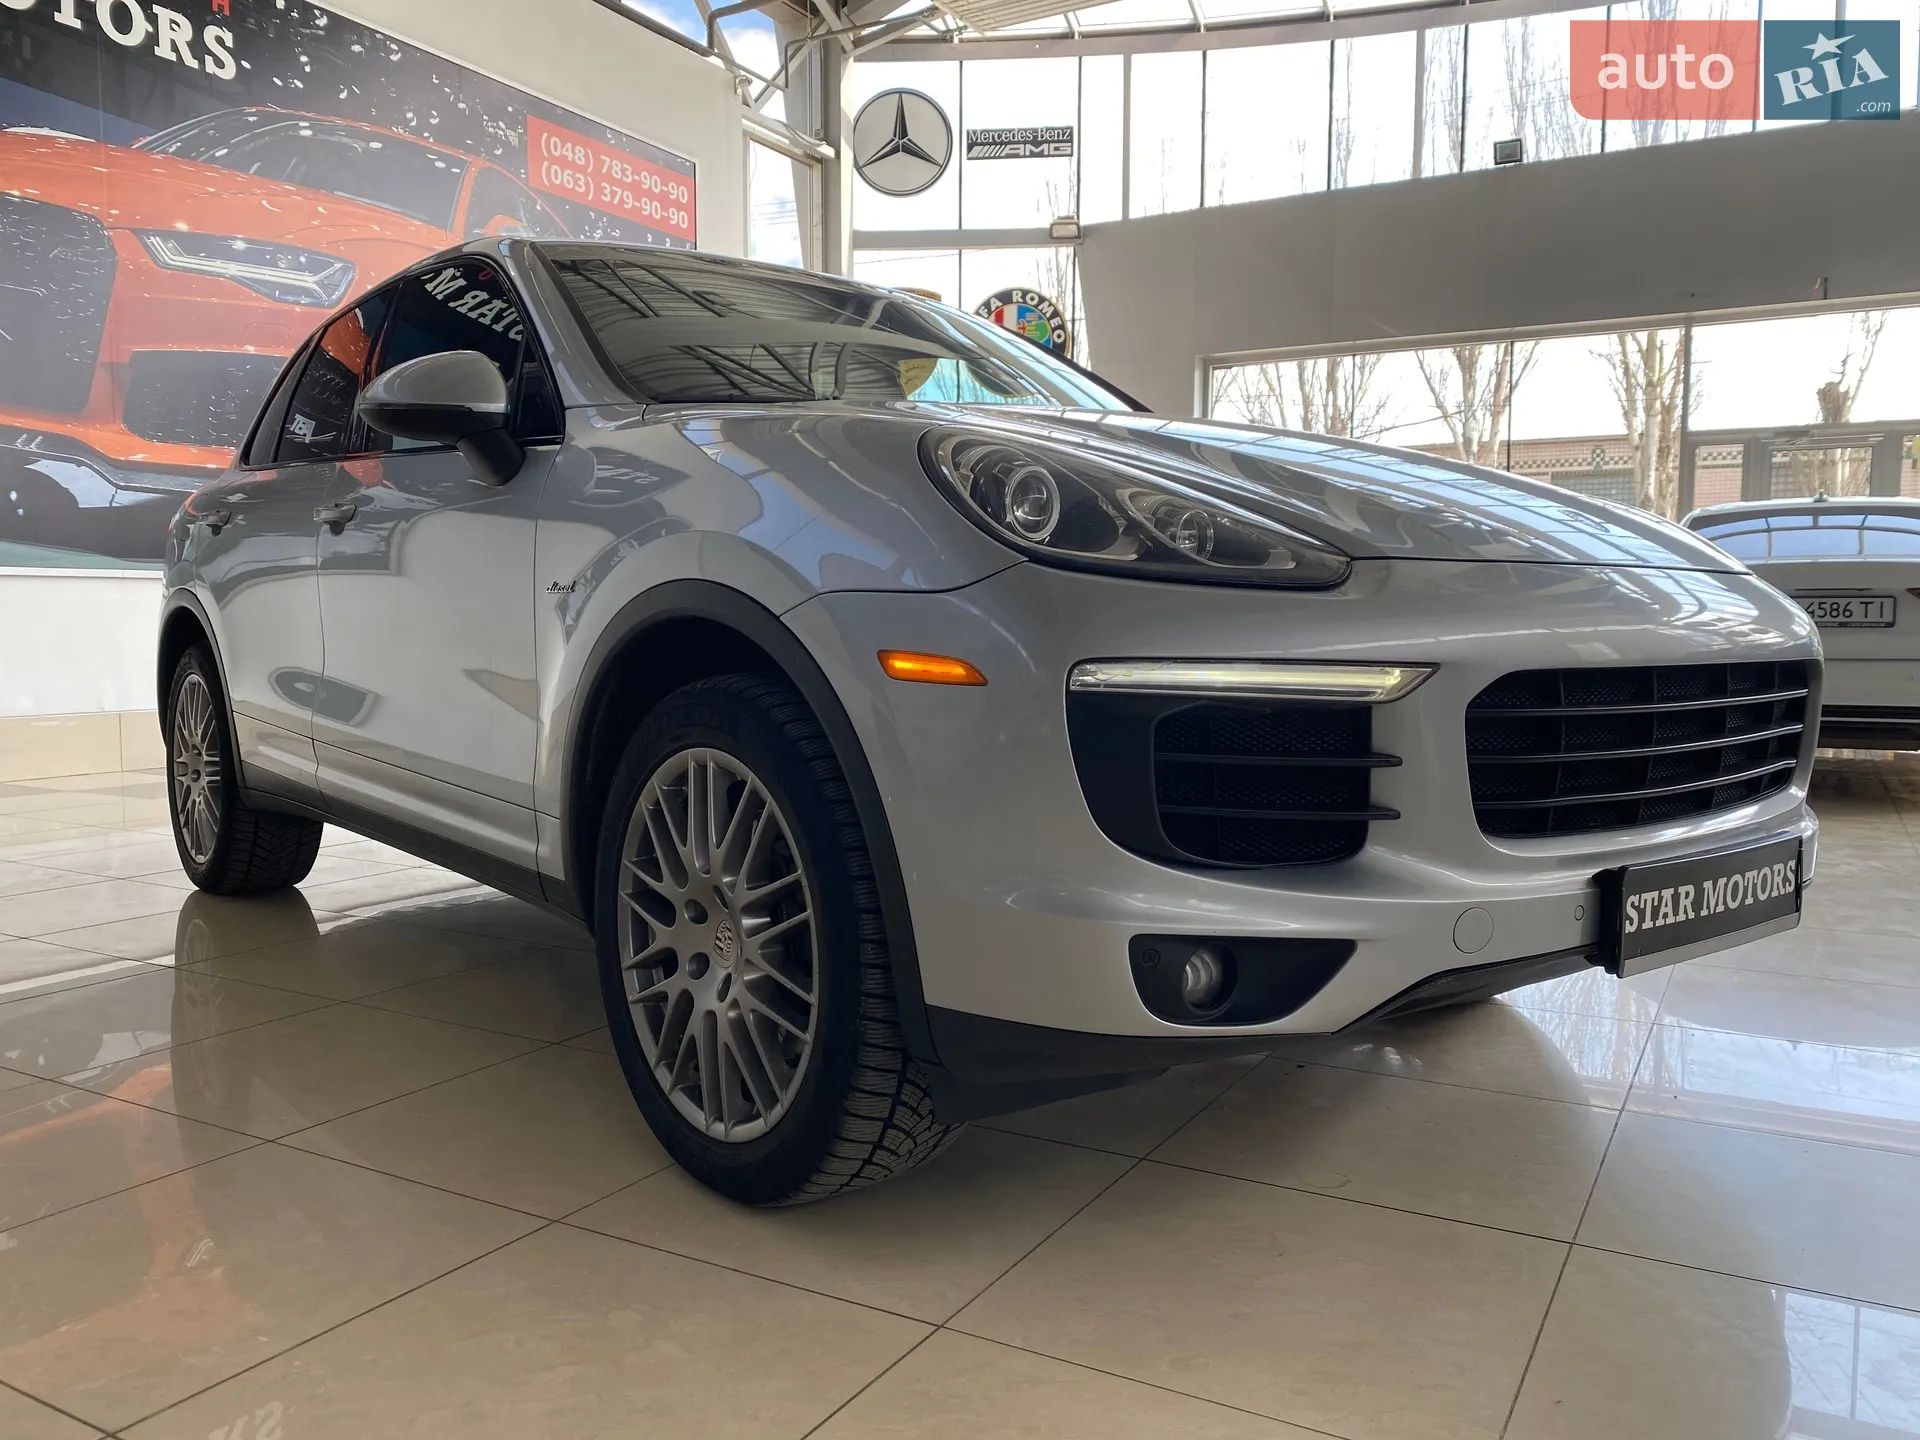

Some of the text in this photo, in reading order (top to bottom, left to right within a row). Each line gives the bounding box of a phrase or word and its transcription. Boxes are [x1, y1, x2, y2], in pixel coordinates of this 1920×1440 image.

[968, 127, 1071, 143] Mercedes-Benz
[541, 132, 688, 204] (048) 783-90-90
[541, 161, 689, 229] (063) 379-90-90
[978, 290, 1066, 343] FA ROMEO
[546, 580, 576, 594] diesel
[1625, 860, 1796, 934] STAR MOTORS
